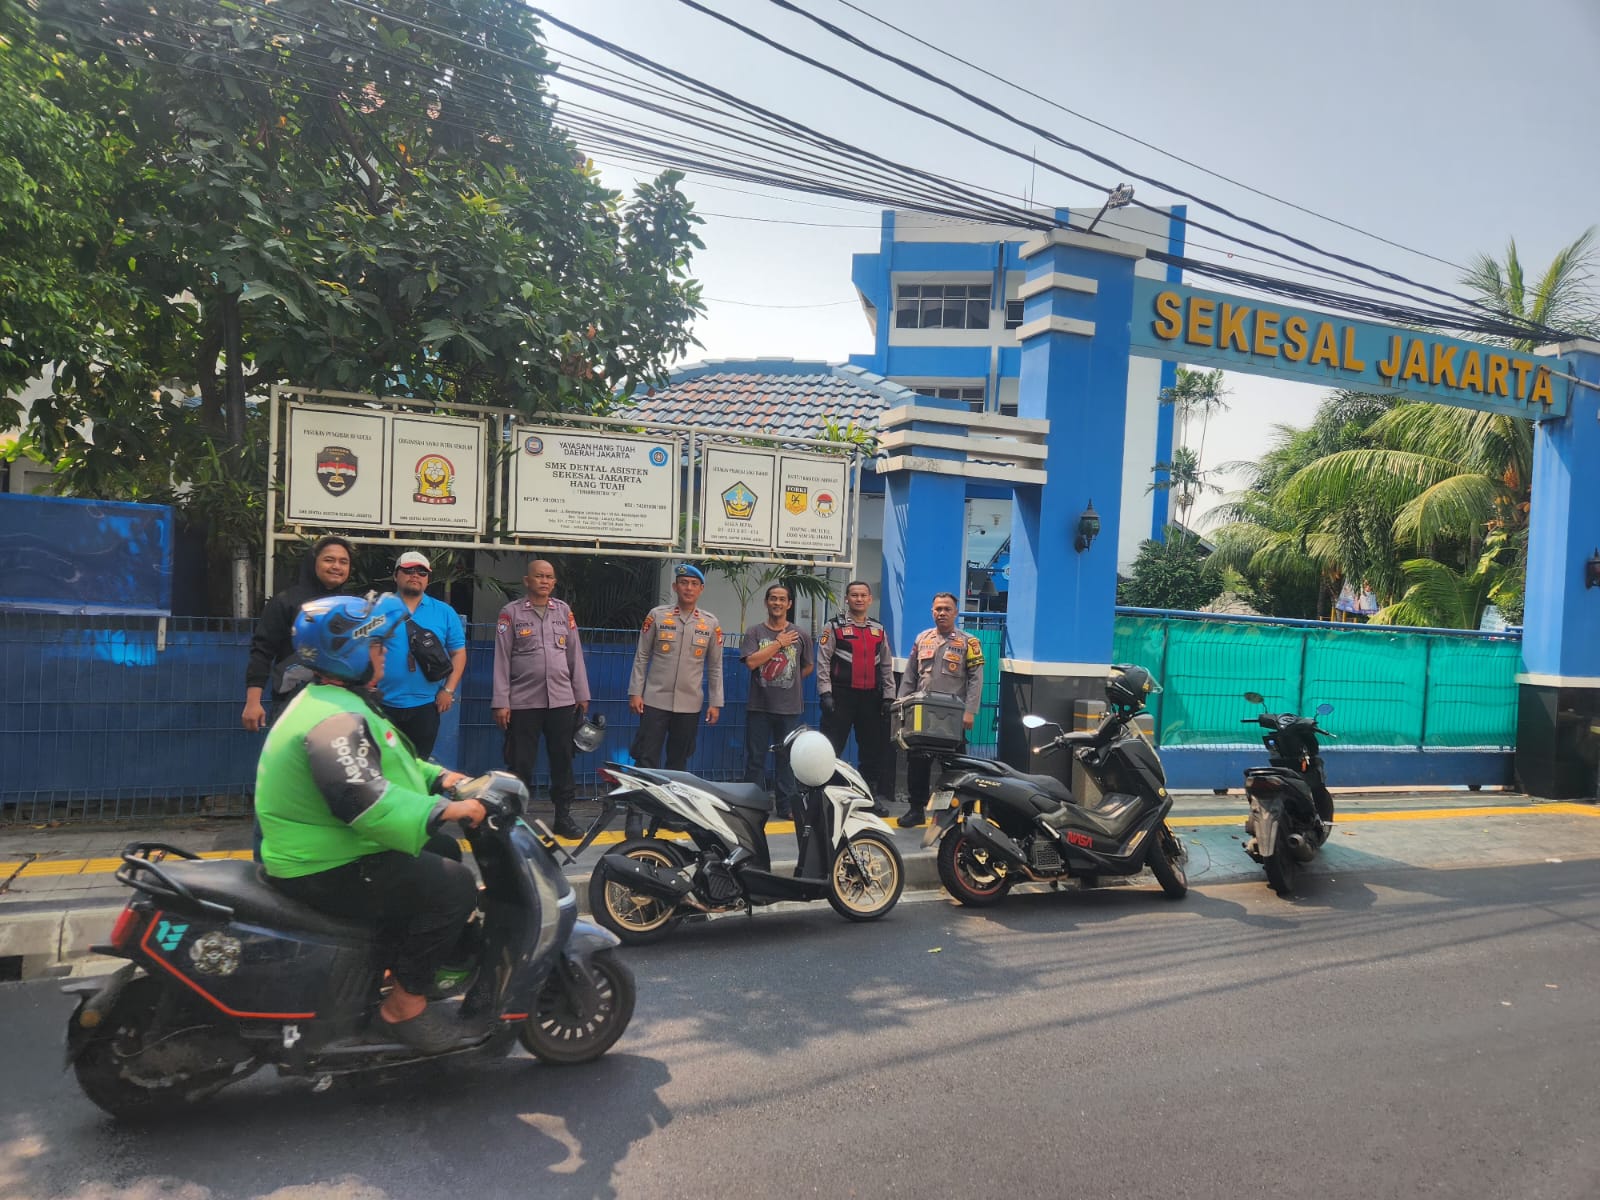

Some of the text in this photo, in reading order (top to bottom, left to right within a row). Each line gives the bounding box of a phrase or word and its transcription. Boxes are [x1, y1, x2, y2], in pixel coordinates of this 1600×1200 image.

[1152, 290, 1555, 405] SEKESAL JAKARTA
[559, 441, 636, 454] YAYASAN HANG TUAH
[564, 449, 631, 459] DAERAH JAKARTA
[544, 462, 649, 476] SMK DENTAL ASISTEN
[552, 471, 642, 484] SEKESAL JAKARTA
[570, 480, 625, 491] HANG TUAH
[330, 736, 366, 785] gopay
[1066, 831, 1093, 849] NASA
